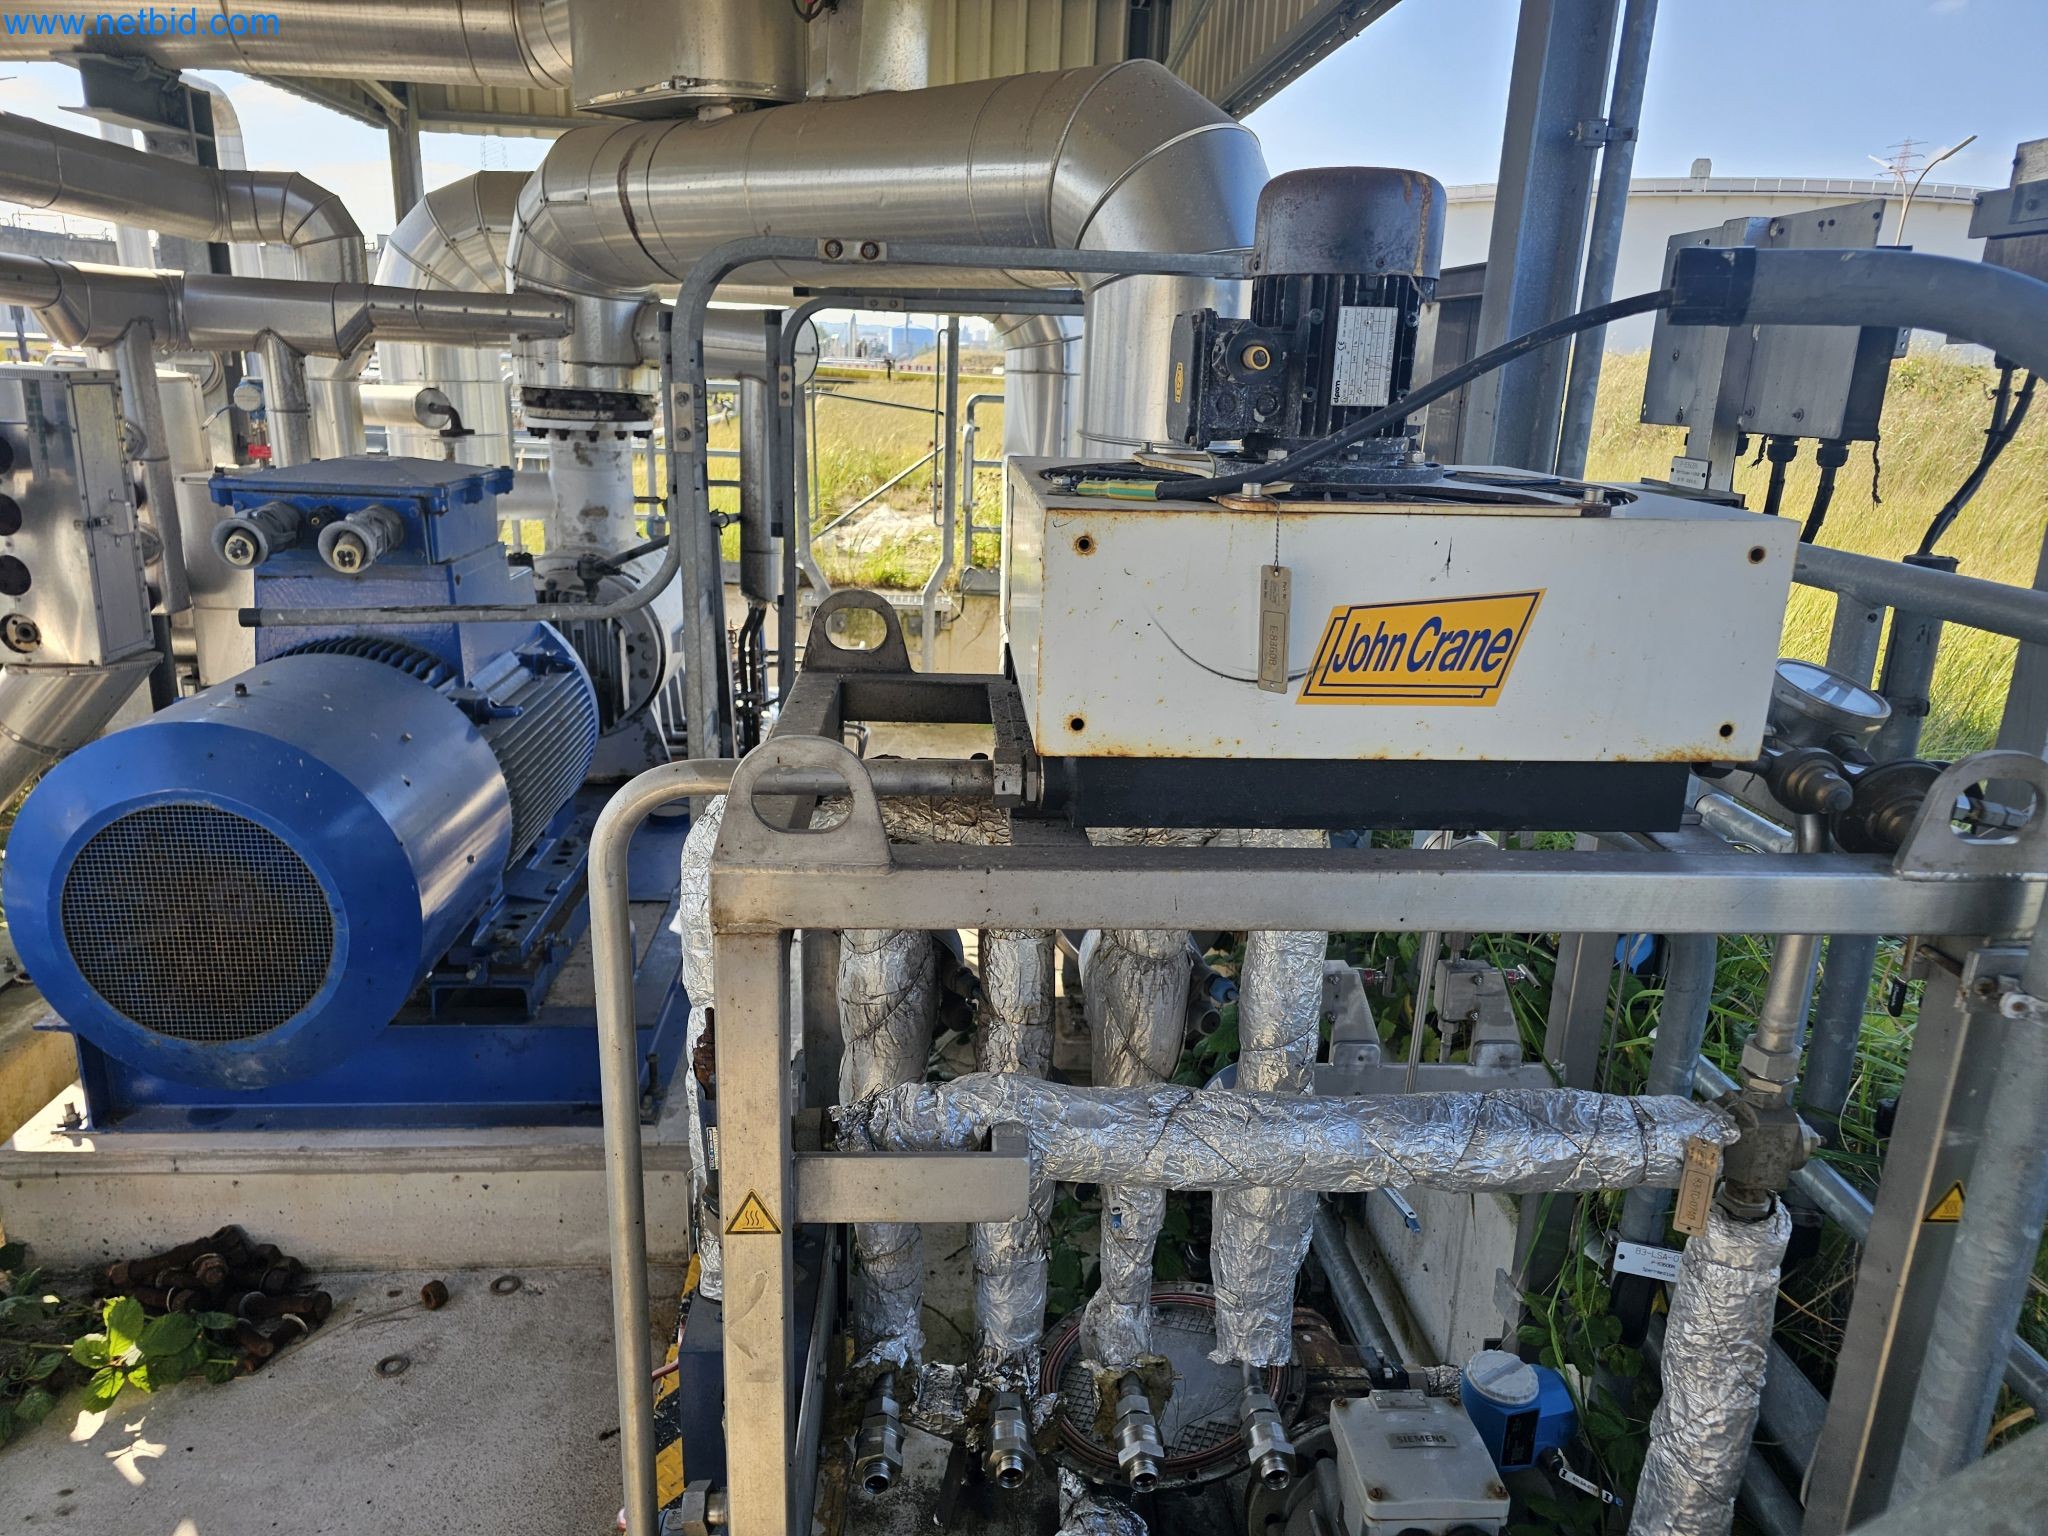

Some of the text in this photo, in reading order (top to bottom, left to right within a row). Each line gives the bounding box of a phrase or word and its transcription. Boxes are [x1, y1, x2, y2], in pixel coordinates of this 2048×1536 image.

[1331, 616, 1513, 673] John Crane
[1634, 1246, 1683, 1263] 83-LSA-0
[1396, 1434, 1448, 1444] SIEMENS
